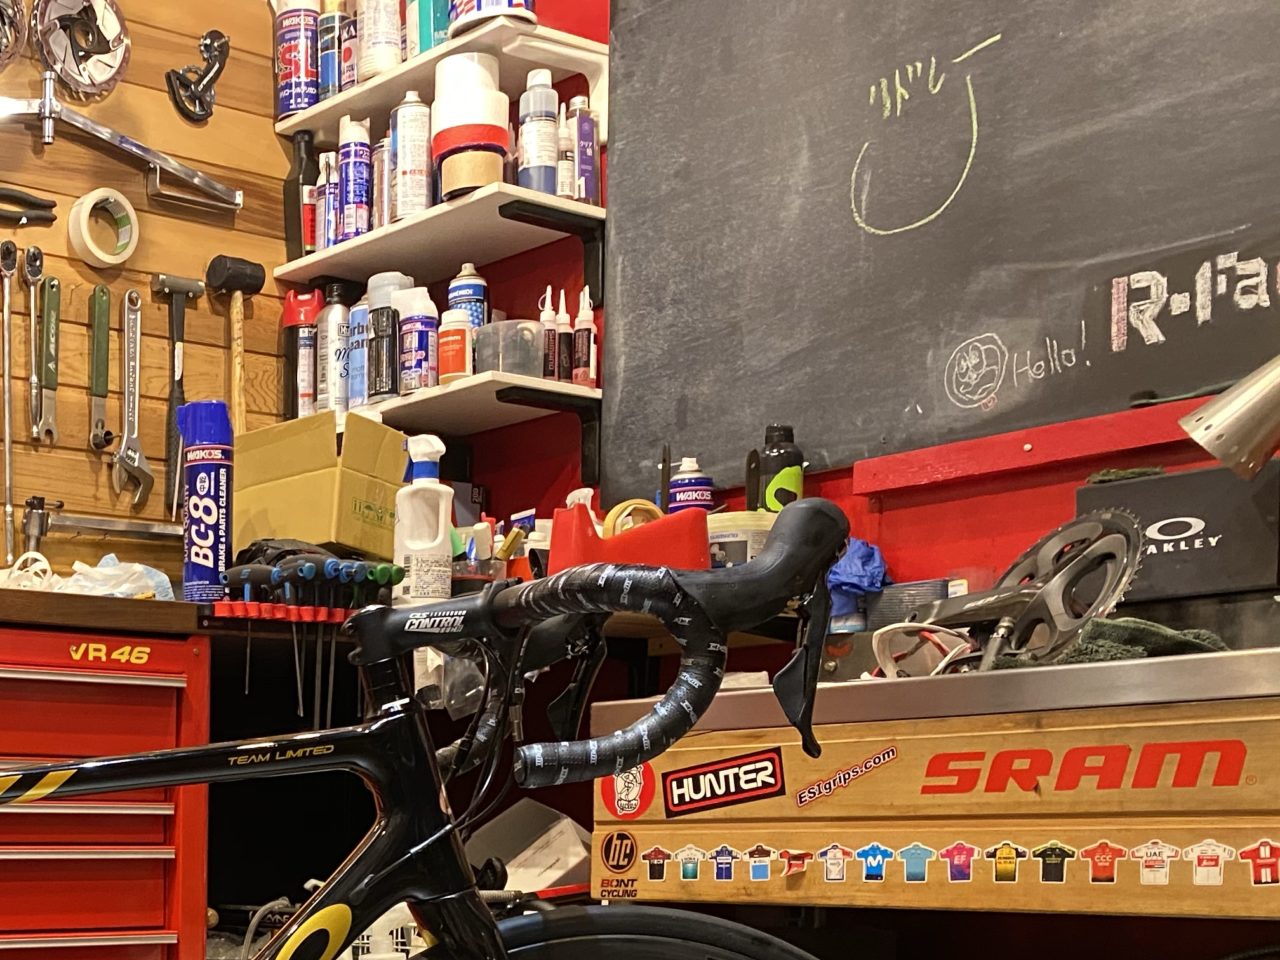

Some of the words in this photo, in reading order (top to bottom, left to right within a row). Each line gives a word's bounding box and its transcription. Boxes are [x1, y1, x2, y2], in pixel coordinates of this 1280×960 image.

[1013, 320, 1092, 387] Hello!
[219, 468, 227, 506] CLEANER
[189, 495, 218, 568] BC-8
[219, 508, 227, 534] PARTS
[1146, 534, 1222, 555] AKLEY
[218, 545, 227, 573] BRAKE
[404, 616, 465, 632] CONTROL
[69, 642, 107, 662] VR
[110, 645, 152, 664] 46
[228, 753, 270, 766] TEAM
[276, 744, 335, 761] LIMITED
[921, 740, 1248, 794] SRAM
[670, 760, 776, 805] HUNTER
[797, 747, 897, 805] ESIgrips.com
[953, 855, 967, 865] EF
[1094, 854, 1113, 862] CCC
[600, 879, 638, 888] BONT
[600, 889, 638, 898] CYCLING
